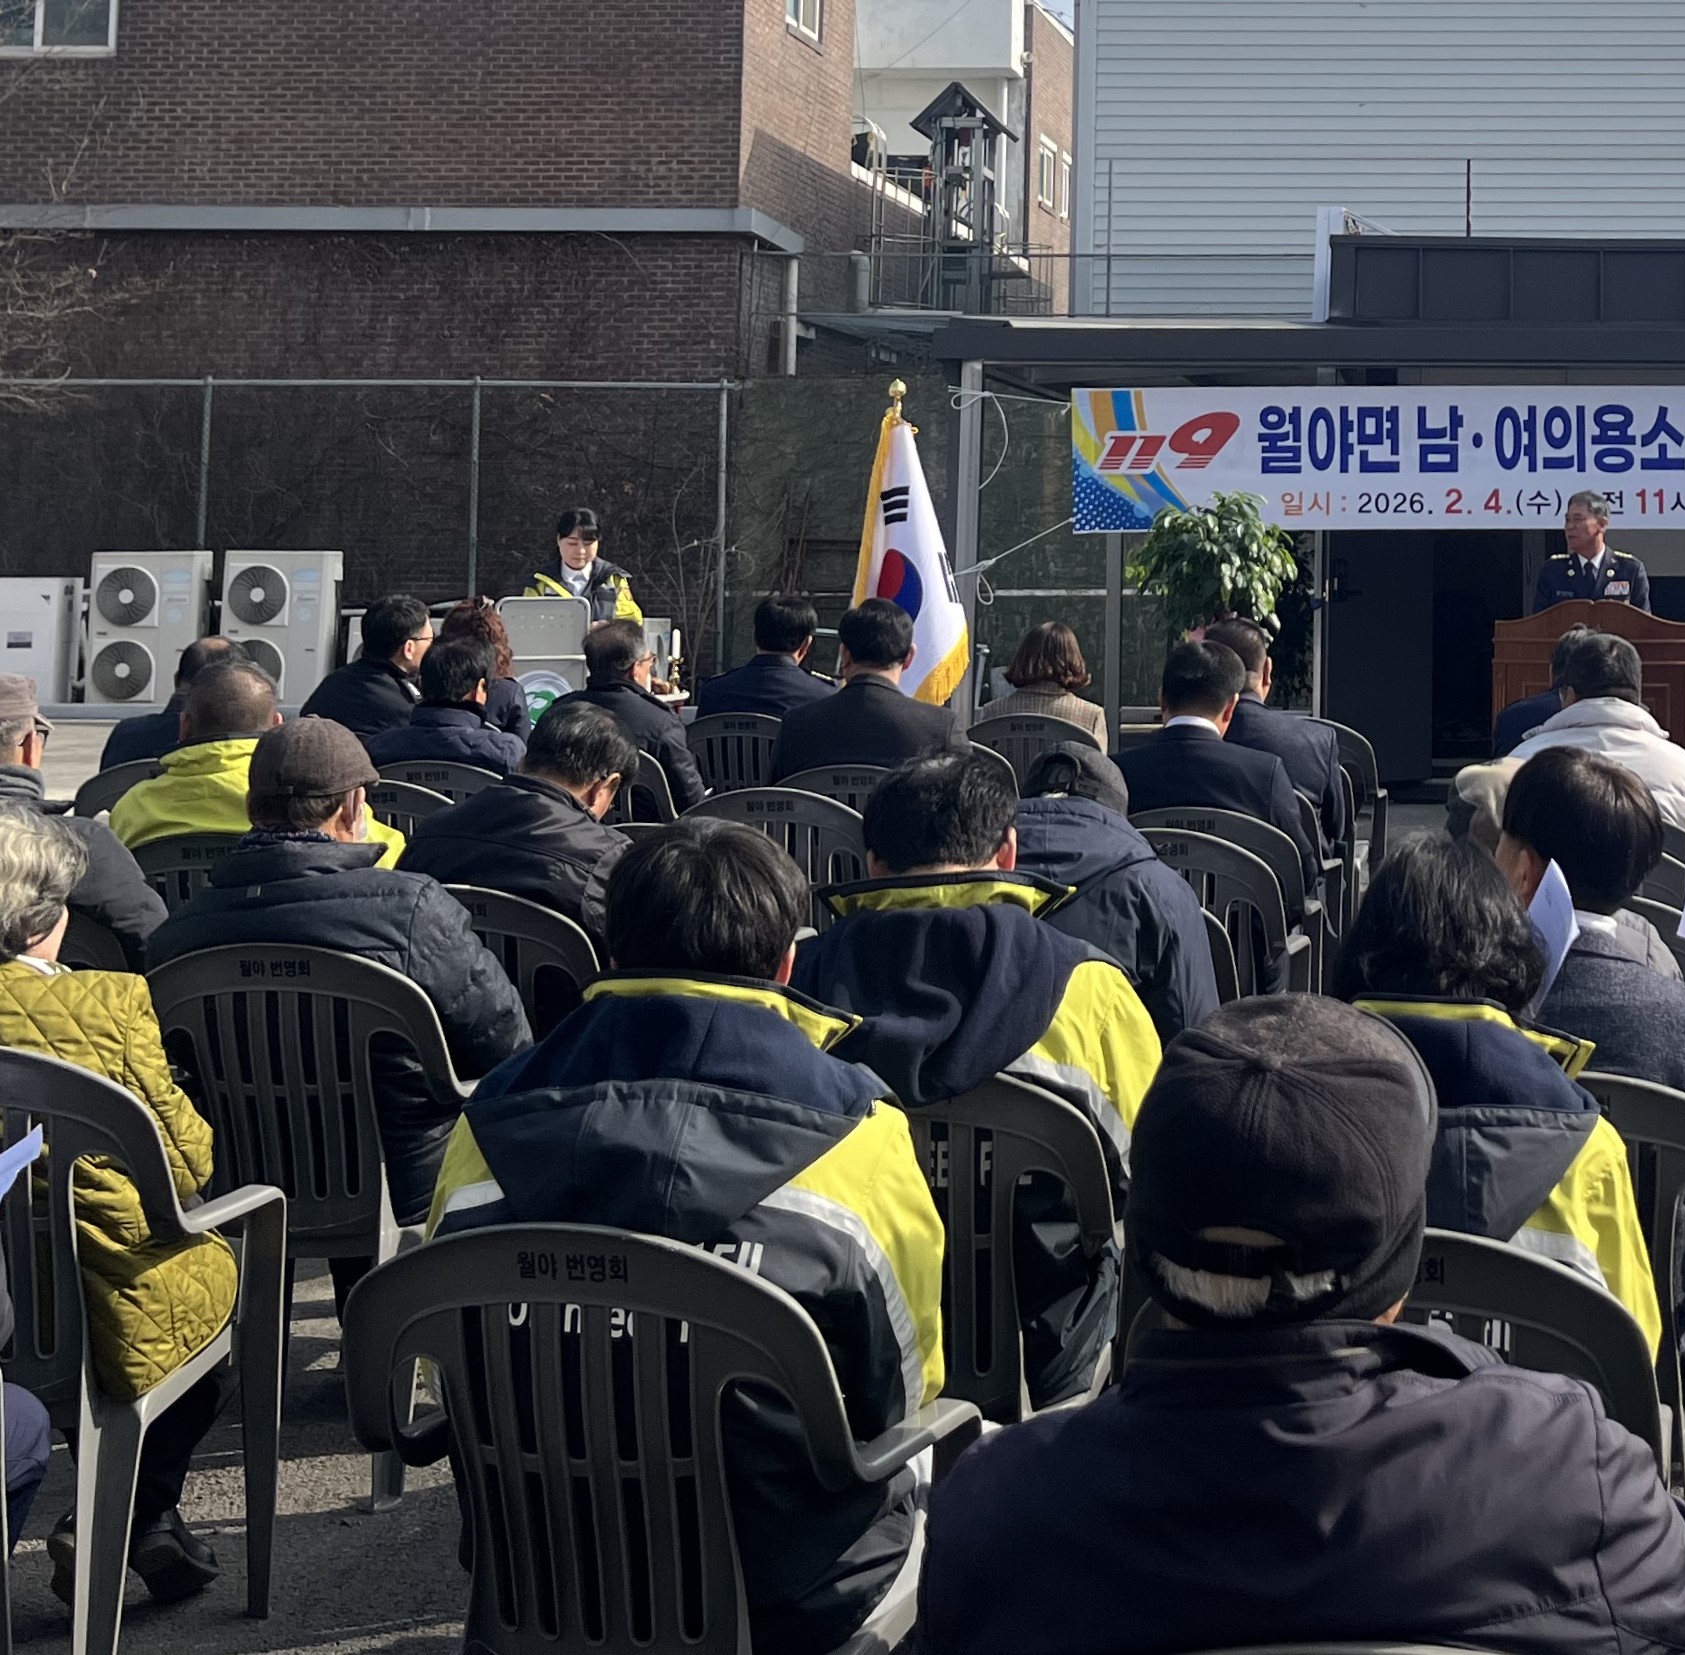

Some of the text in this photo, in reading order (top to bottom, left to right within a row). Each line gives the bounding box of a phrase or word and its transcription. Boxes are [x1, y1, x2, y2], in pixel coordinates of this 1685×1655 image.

[1098, 411, 1240, 470] 119
[1257, 404, 1401, 474] 월야면
[1357, 491, 1434, 515] 2026.
[1602, 489, 1624, 516] 전
[517, 1251, 629, 1284] 월야 번영회
